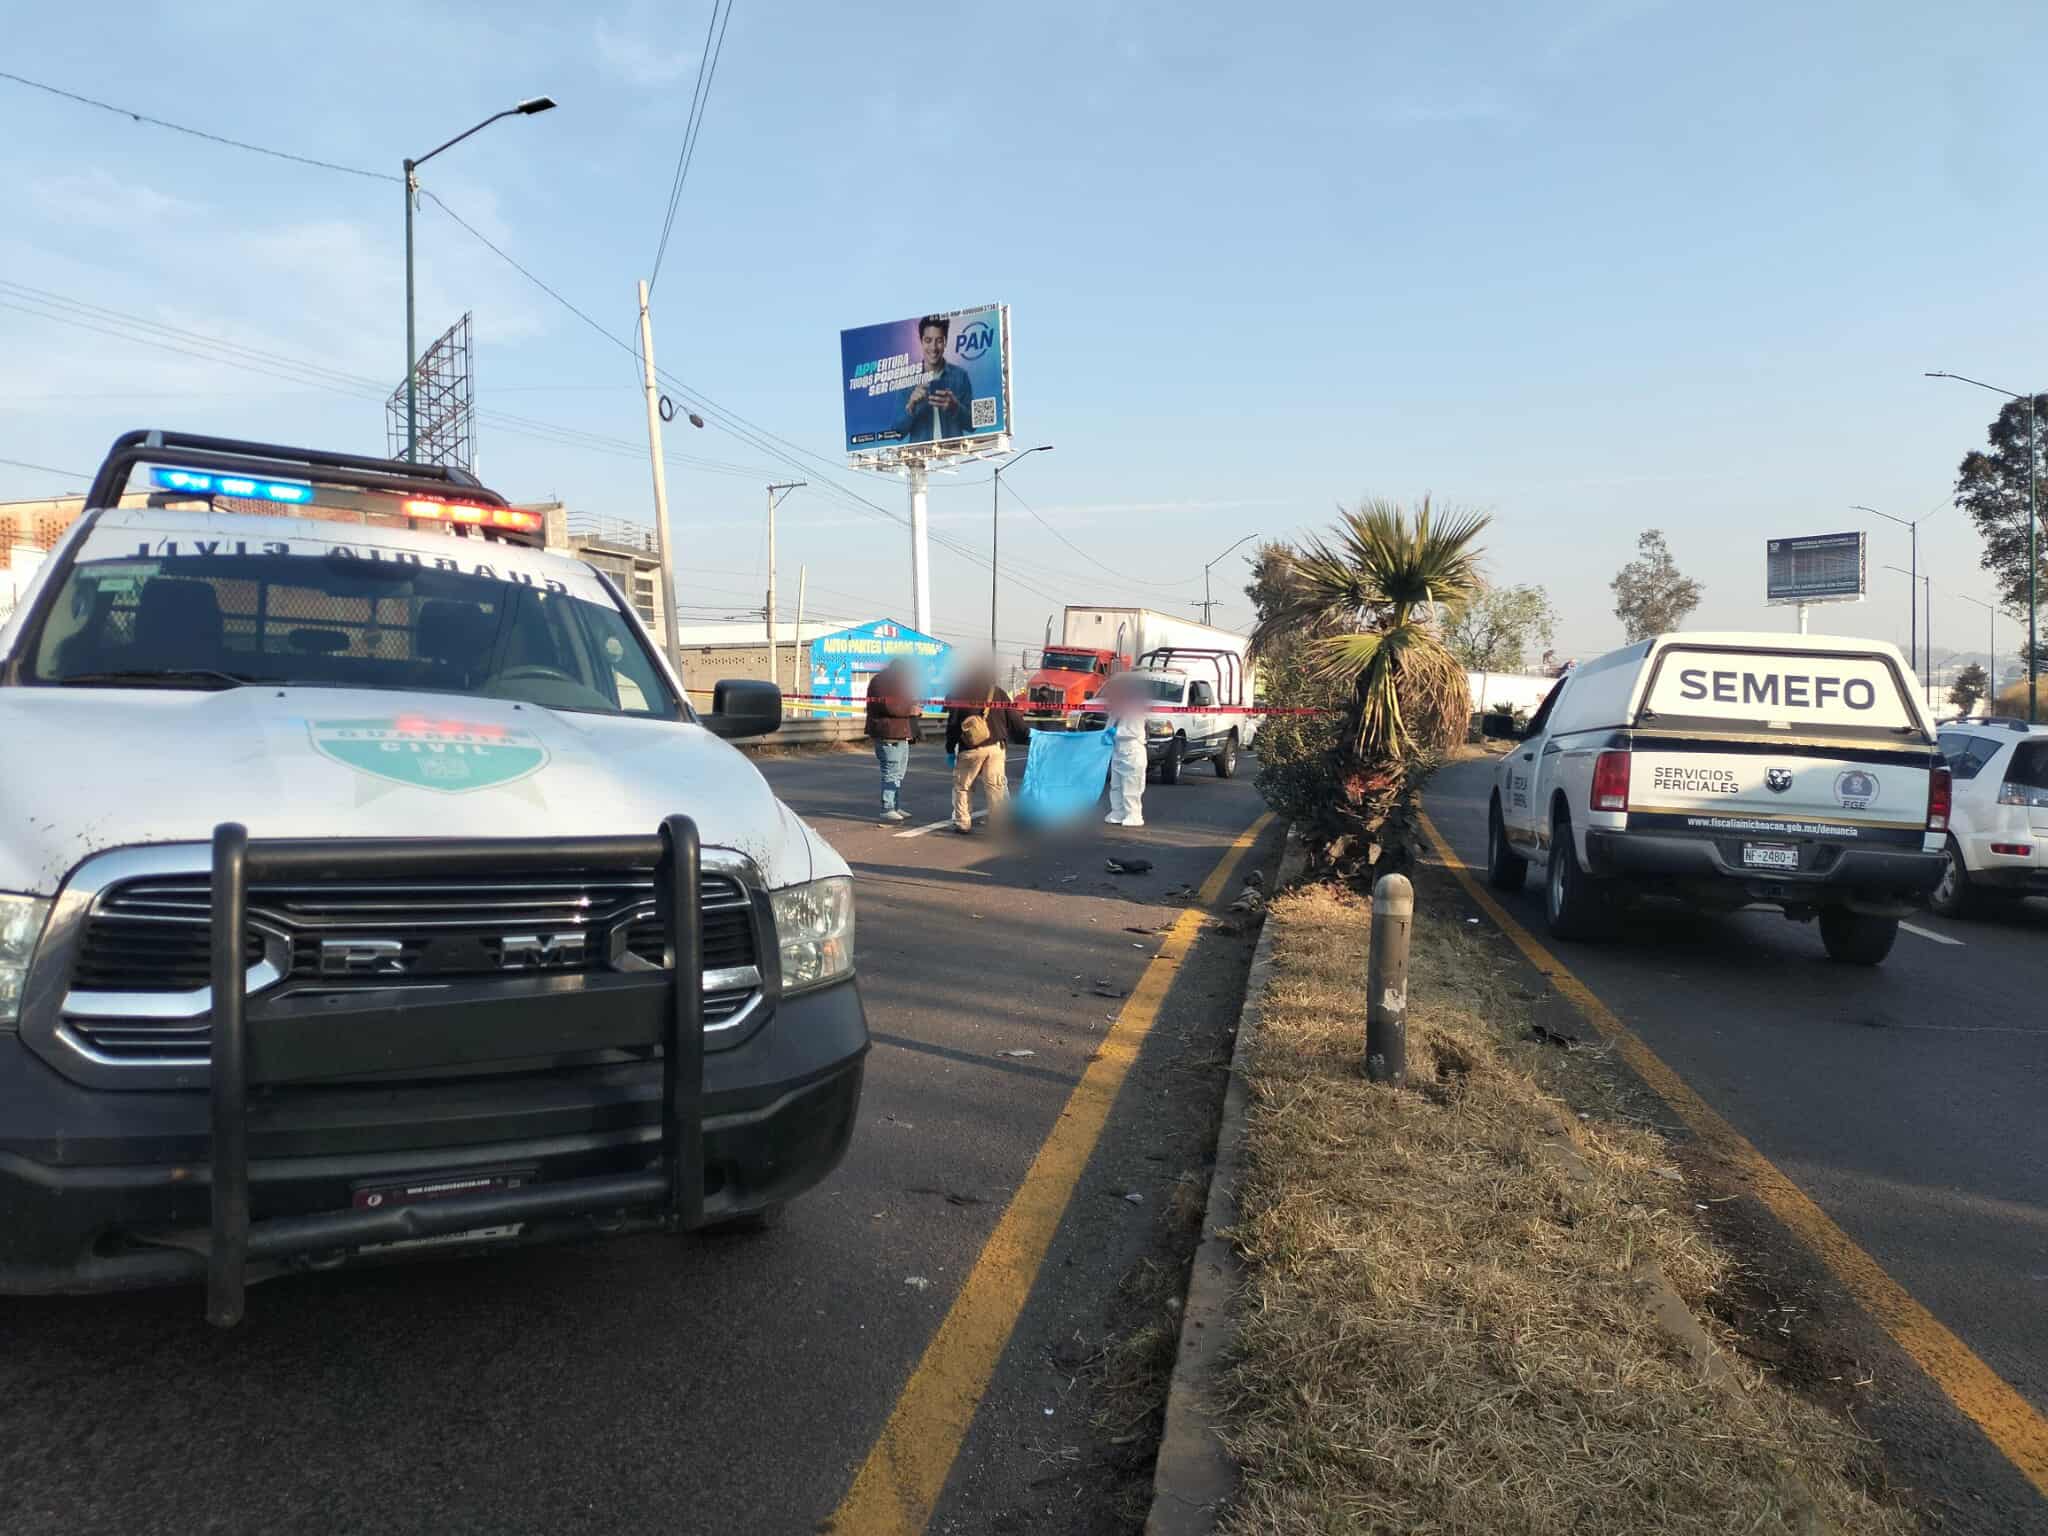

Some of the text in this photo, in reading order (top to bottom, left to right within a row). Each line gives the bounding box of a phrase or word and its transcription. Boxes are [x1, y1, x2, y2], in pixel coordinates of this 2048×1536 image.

[956, 327, 994, 353] PAN
[874, 362, 923, 383] PODEMOS
[868, 382, 888, 396] SER
[824, 638, 847, 654] AUTO
[1680, 668, 1876, 711] SEMEFO
[380, 741, 491, 756] CIVIL
[1655, 766, 1734, 782] SERVICIOS
[1654, 779, 1739, 794] PERICIALES
[1842, 800, 1866, 810] FGE
[1686, 816, 1858, 837] www.fiscaliamichoacan.gob.mx/denuncia
